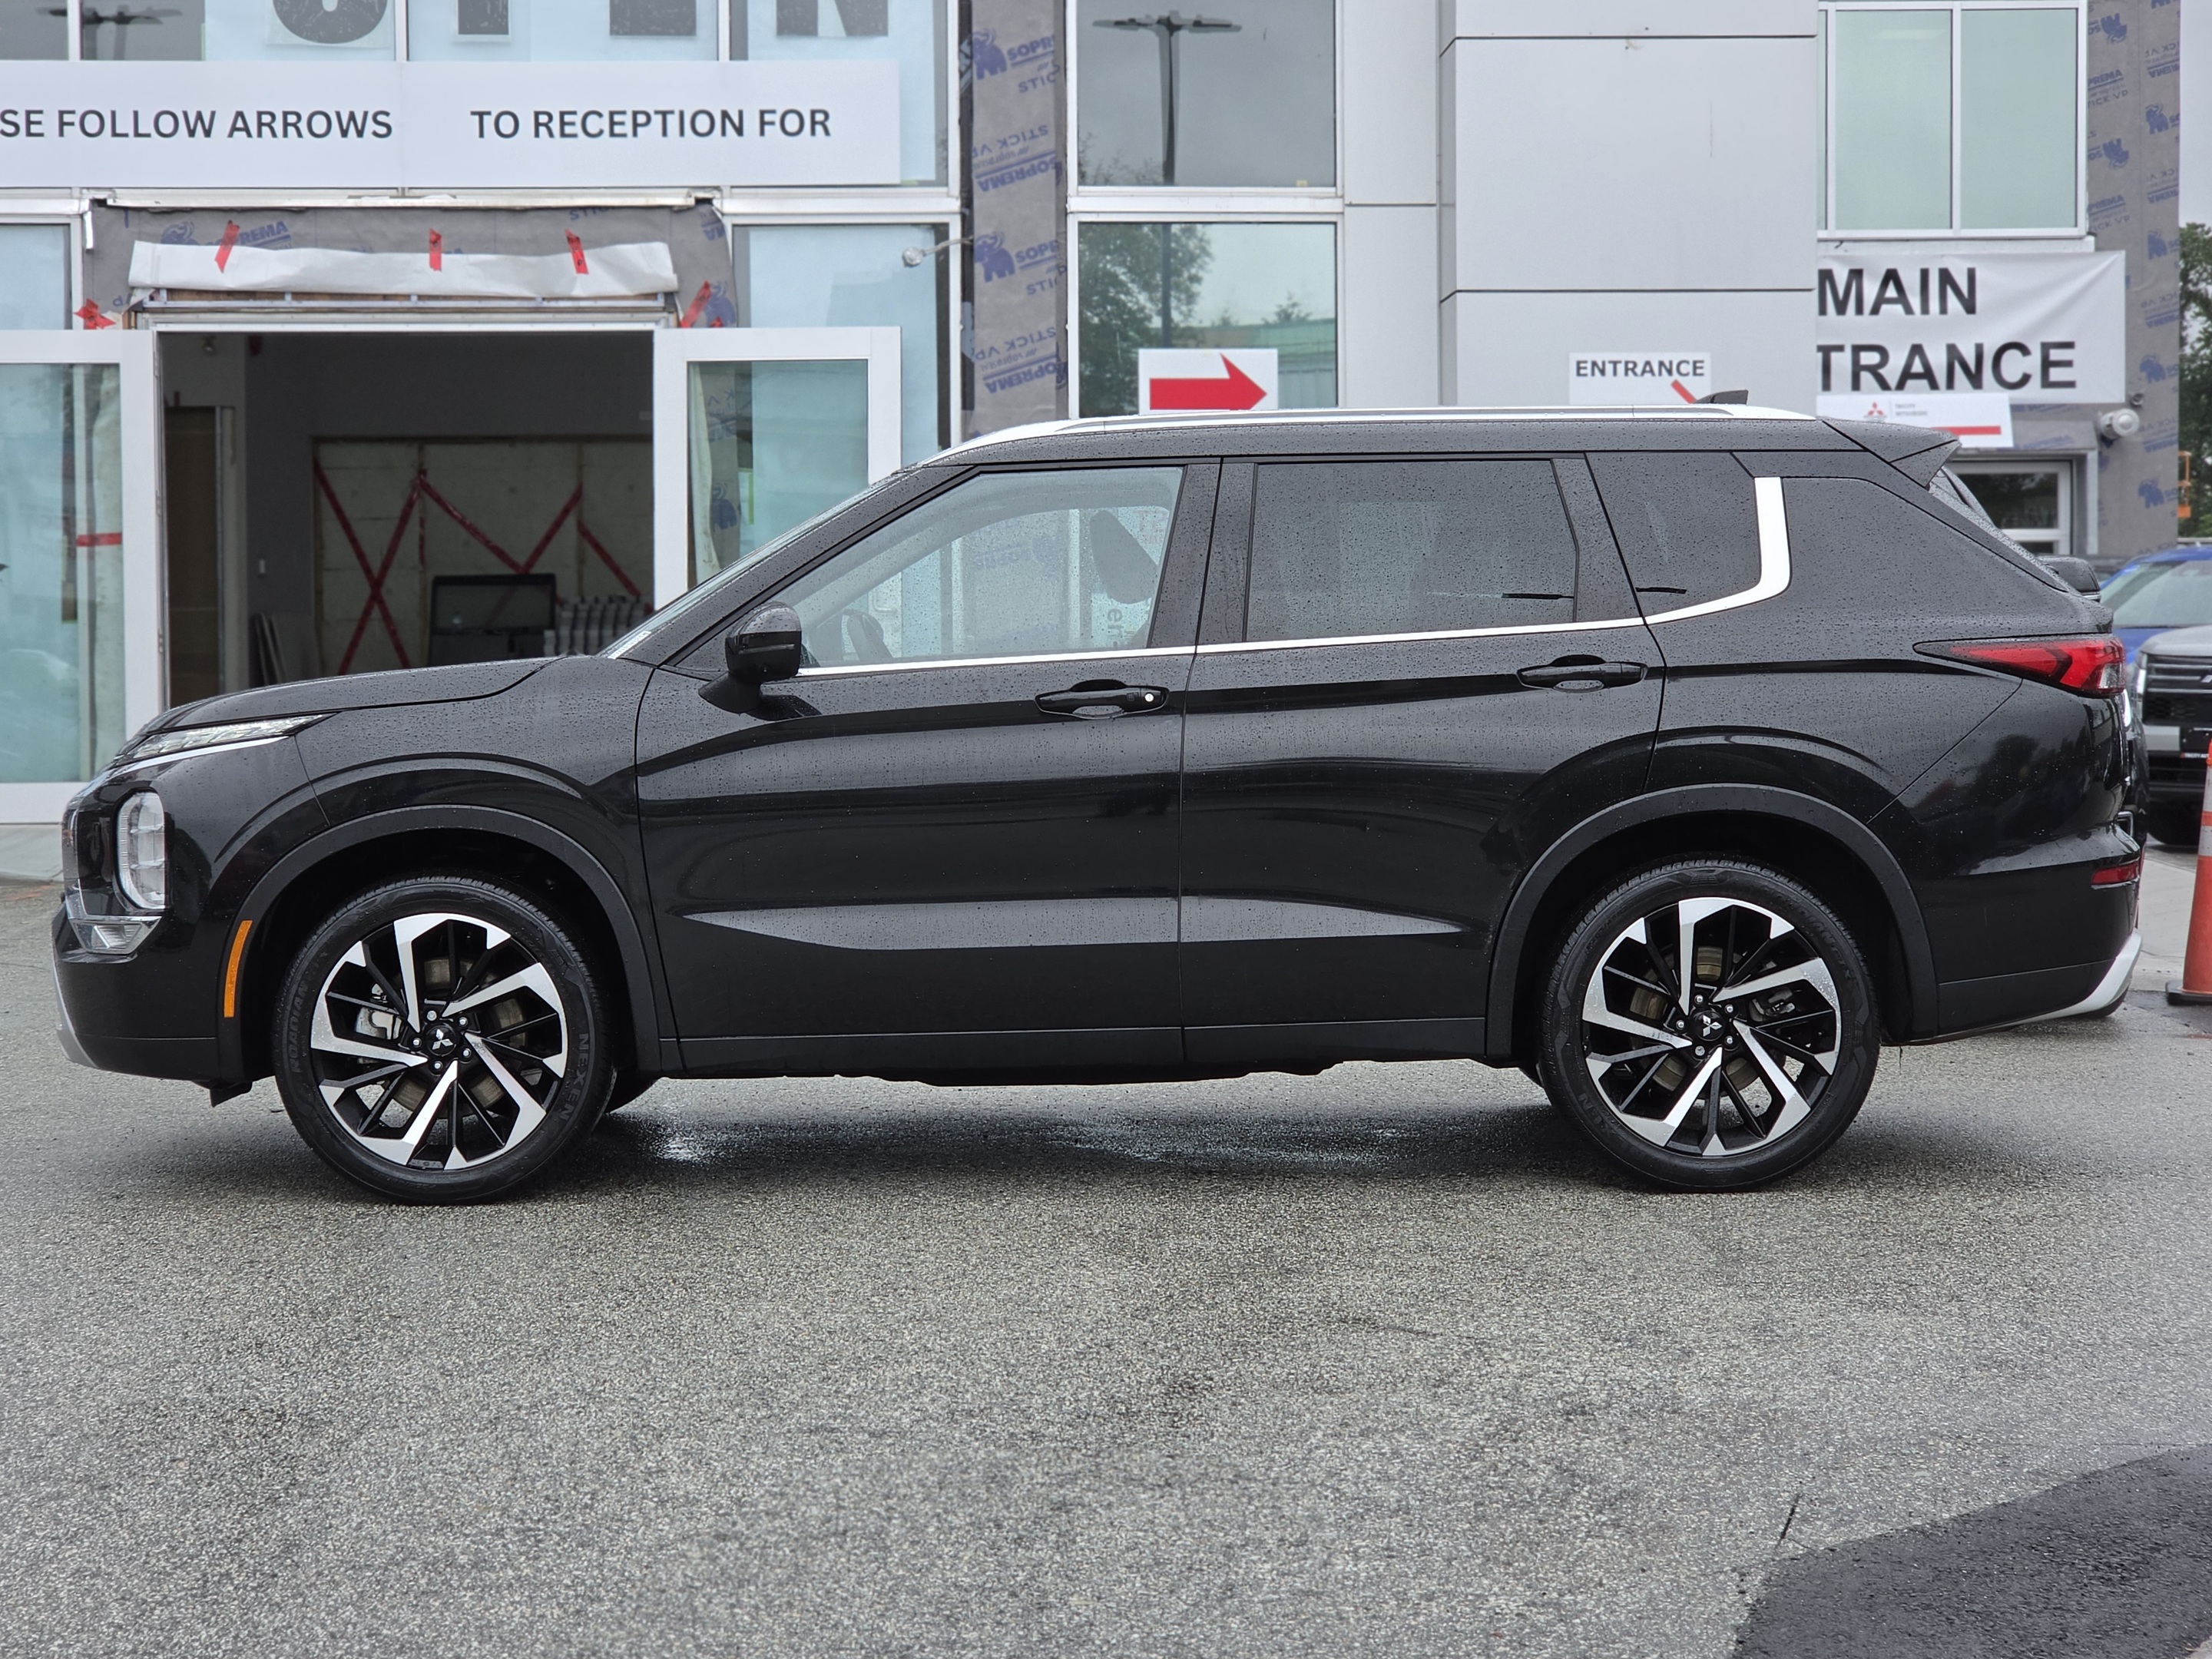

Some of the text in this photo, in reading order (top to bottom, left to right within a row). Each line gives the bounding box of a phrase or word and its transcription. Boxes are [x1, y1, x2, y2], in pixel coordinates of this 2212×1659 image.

[0, 109, 830, 138] SE FOLLOW ARROWS TO RECEPTION FOR
[1817, 267, 1976, 316] MAIN
[1575, 359, 1705, 377] ENTRANCE
[1816, 341, 2077, 392] TRANCE
[558, 1032, 590, 1121] NEXEN
